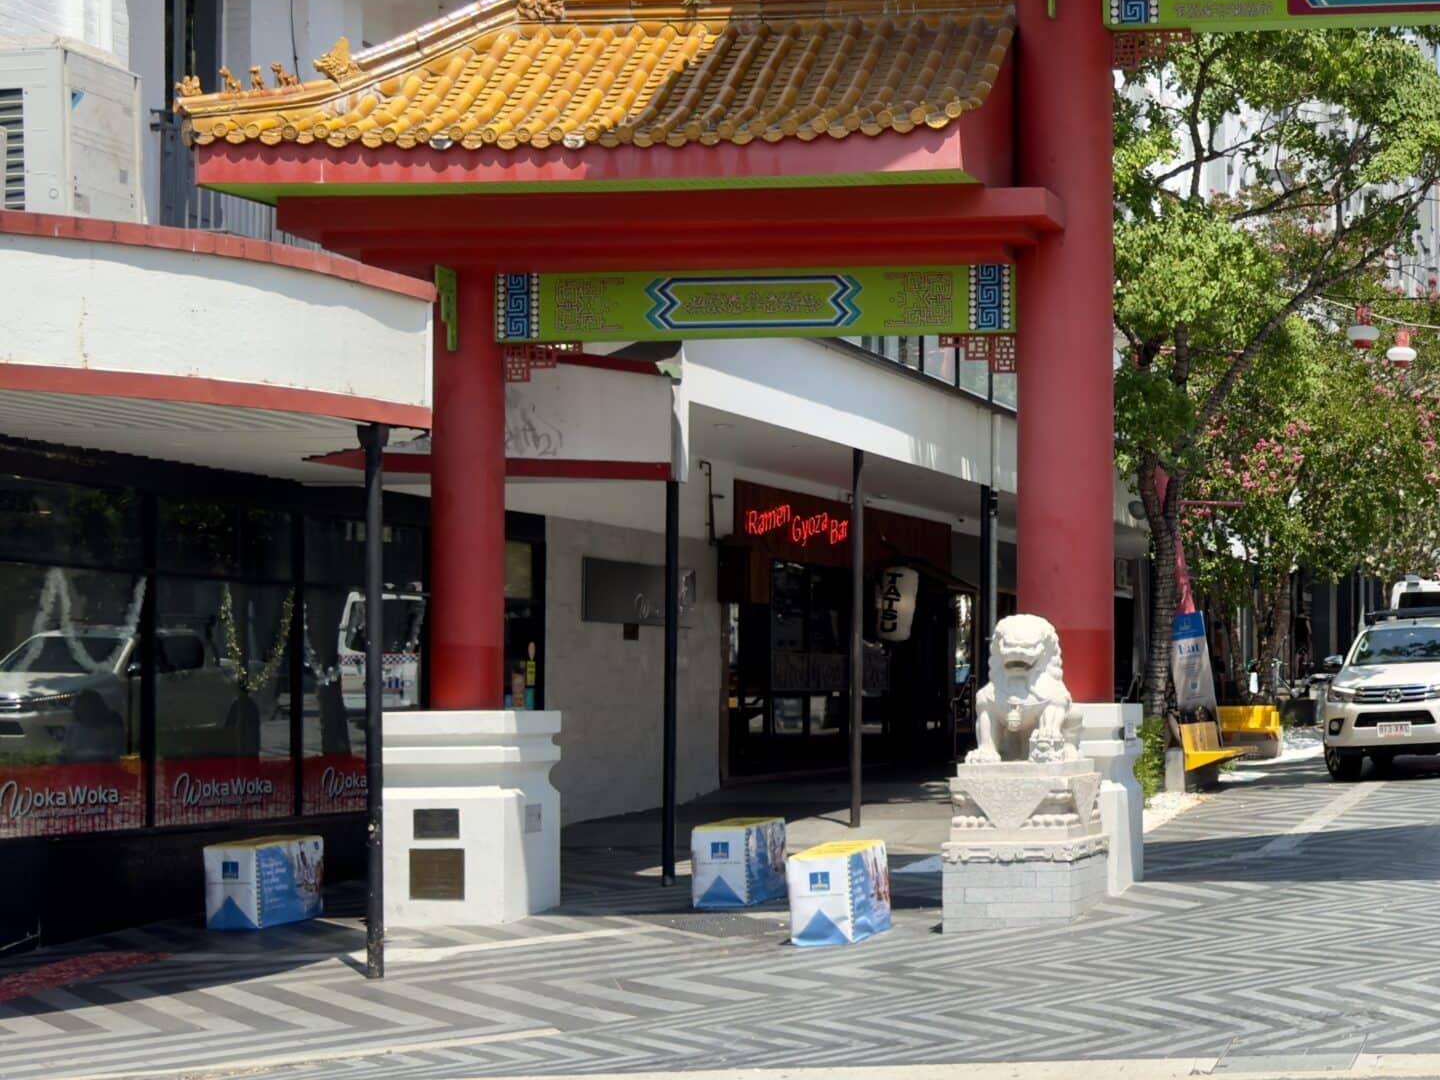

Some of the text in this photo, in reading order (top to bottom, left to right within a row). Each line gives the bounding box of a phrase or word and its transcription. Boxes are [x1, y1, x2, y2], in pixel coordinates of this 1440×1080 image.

[747, 504, 849, 547] Ramen Gyoza Bar
[879, 572, 904, 632] TATSU
[0, 780, 120, 819] Woka Woka
[174, 772, 274, 808] Woka Woka
[321, 766, 368, 799] Woka
